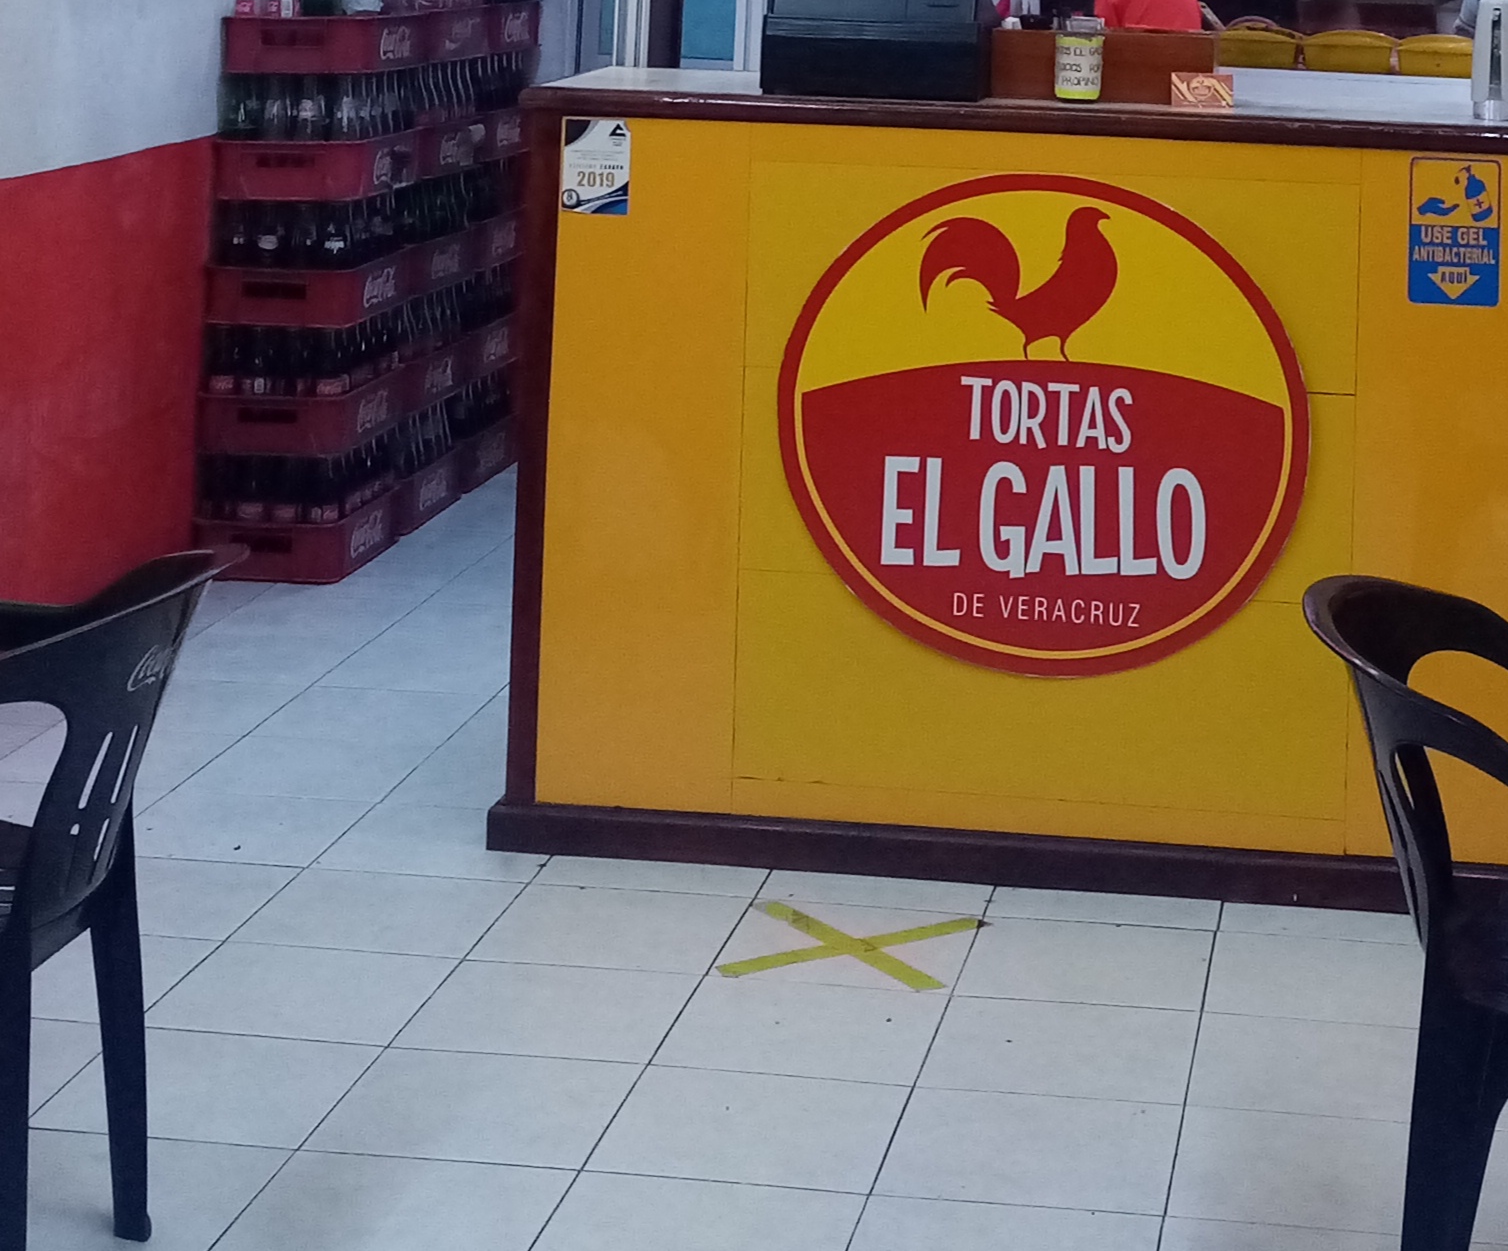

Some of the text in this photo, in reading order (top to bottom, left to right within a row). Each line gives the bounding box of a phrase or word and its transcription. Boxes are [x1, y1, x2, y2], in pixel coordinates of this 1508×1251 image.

[576, 170, 616, 188] 2019
[1421, 226, 1488, 246] USE GEL
[1412, 245, 1496, 265] ANTIBACTERIAL
[960, 375, 1134, 454] TORTAS
[879, 454, 1207, 580] EL GALLO
[952, 591, 1142, 628] DE VERACRUZ
